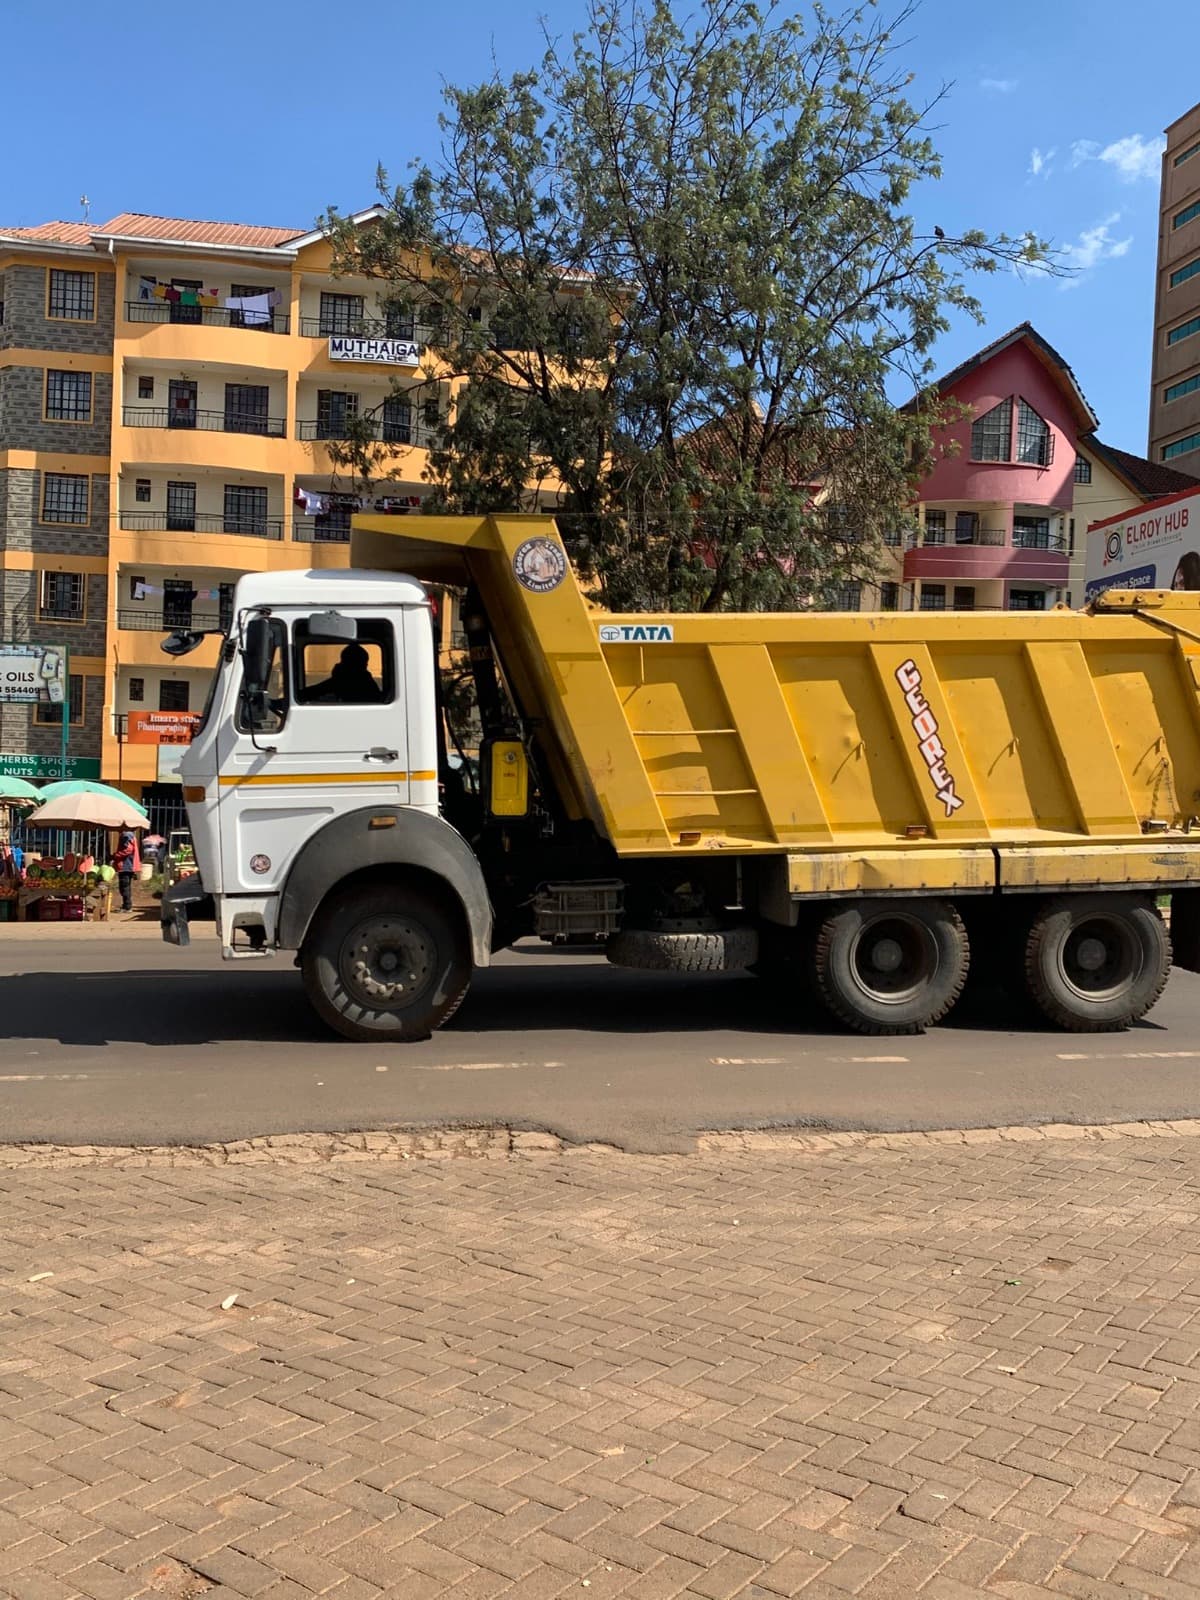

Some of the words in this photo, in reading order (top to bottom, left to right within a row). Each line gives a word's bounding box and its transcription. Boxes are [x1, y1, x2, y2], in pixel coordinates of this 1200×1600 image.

[332, 340, 418, 357] MUTHAIGA
[341, 352, 408, 362] ARCADE
[1126, 517, 1161, 545] ELROY
[1164, 508, 1189, 534] HUB
[527, 578, 557, 590] Limited
[1128, 574, 1151, 590] Space
[621, 627, 672, 641] TATA
[6, 672, 35, 682] OILS
[0, 756, 37, 765] HERBS,
[41, 757, 77, 766] SPICES
[3, 767, 33, 776] NUTS
[37, 769, 44, 777] &
[48, 769, 73, 777] OIS
